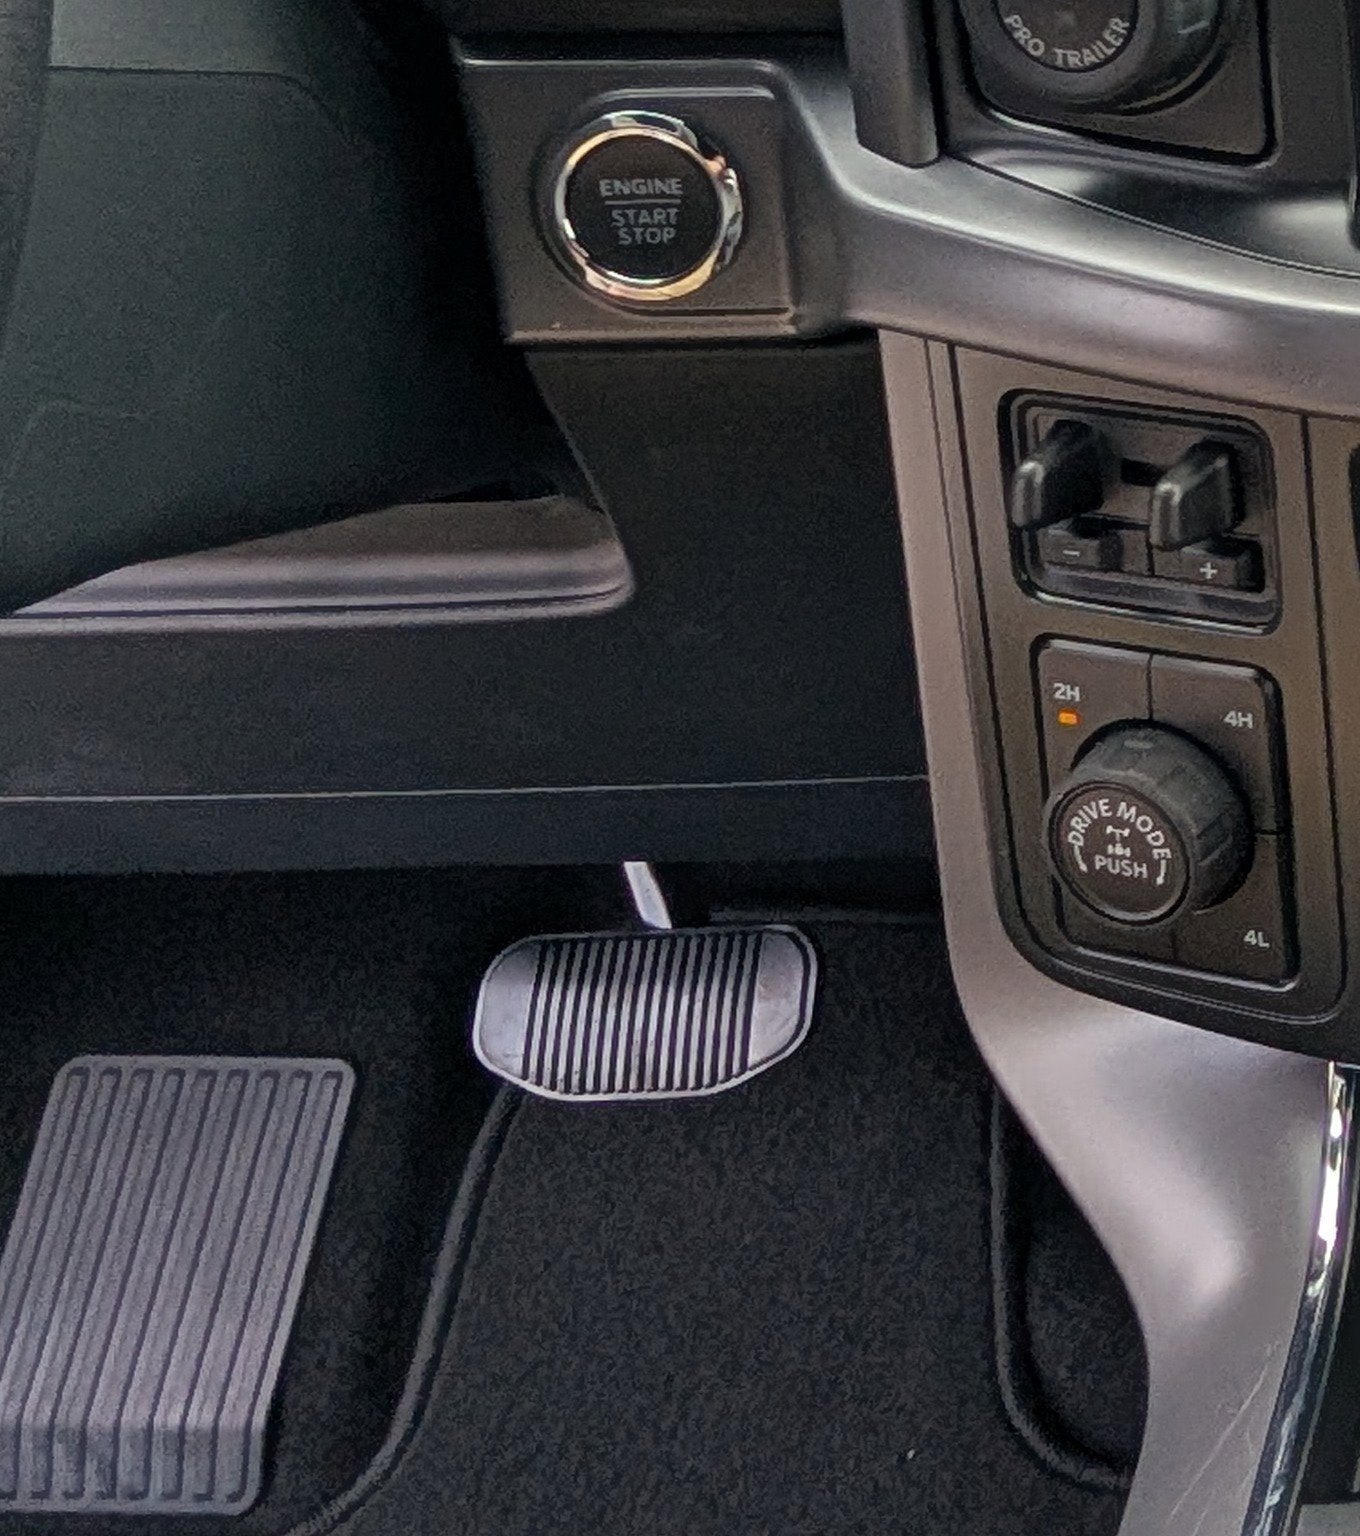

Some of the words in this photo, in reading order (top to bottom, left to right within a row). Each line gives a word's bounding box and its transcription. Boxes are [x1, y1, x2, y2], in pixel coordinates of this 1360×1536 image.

[1003, 14, 1046, 57] PRO
[1053, 16, 1131, 67] TRAILER
[599, 177, 684, 197] ENGINE
[611, 207, 680, 227] START
[618, 226, 677, 245] STOP
[1053, 682, 1081, 702] 2H
[1223, 710, 1253, 729] 4H
[1067, 798, 1113, 847] DRIVE
[1116, 801, 1172, 859] MODE
[1094, 853, 1149, 879] PUSH
[1243, 929, 1271, 949] 4L
